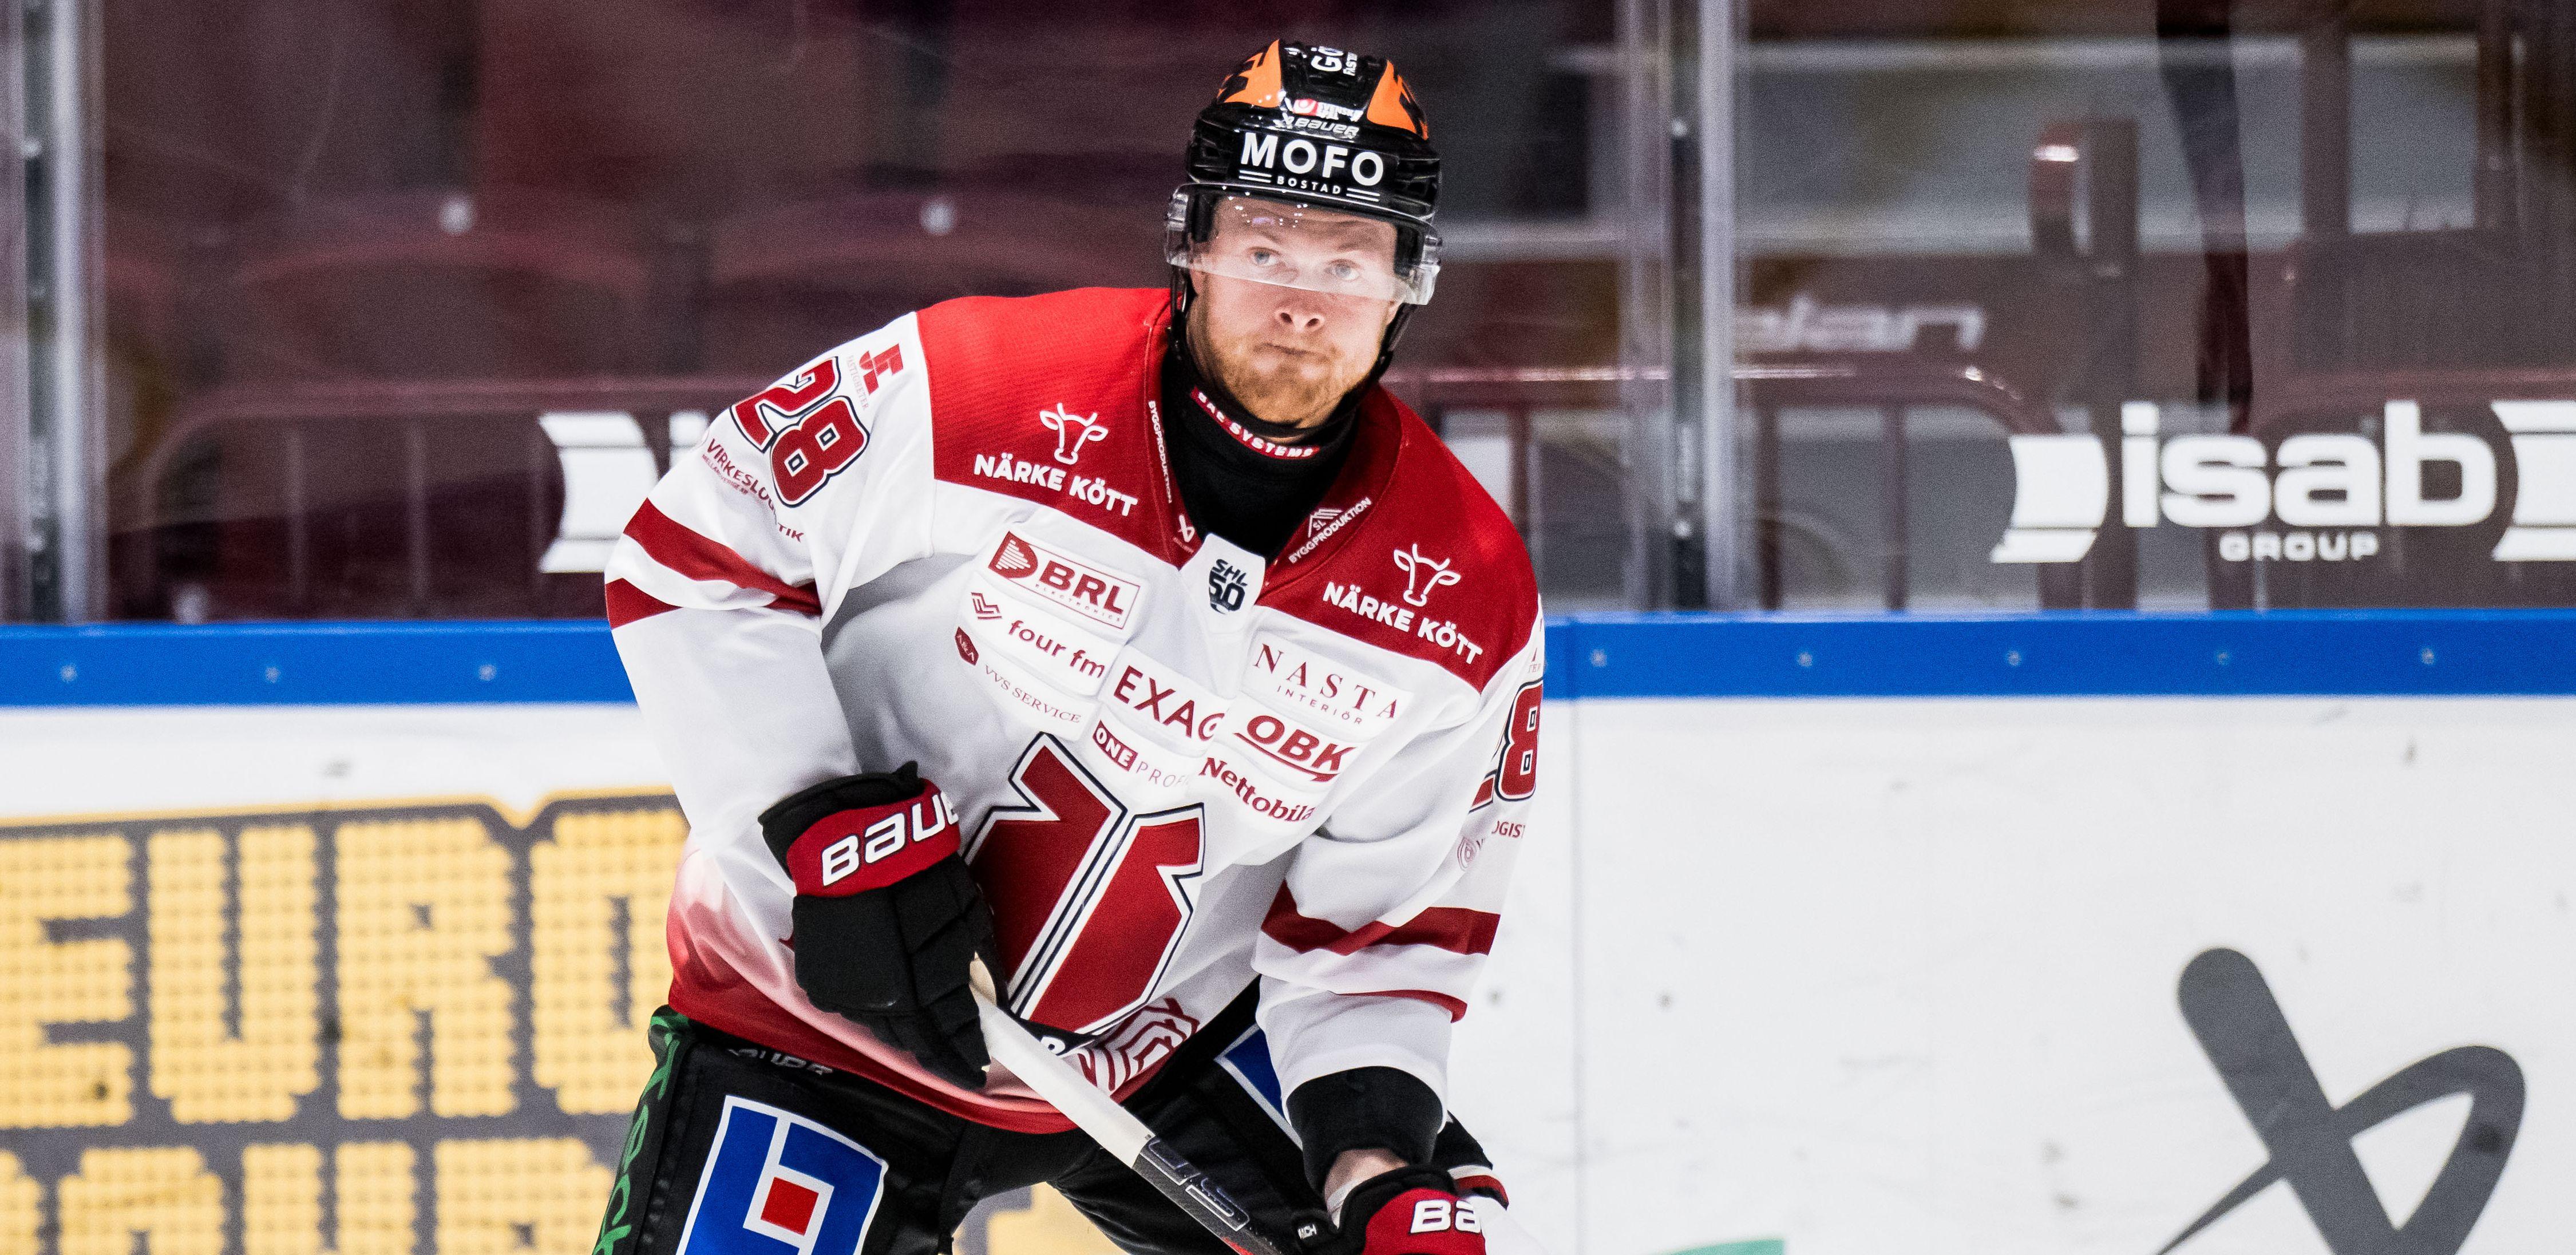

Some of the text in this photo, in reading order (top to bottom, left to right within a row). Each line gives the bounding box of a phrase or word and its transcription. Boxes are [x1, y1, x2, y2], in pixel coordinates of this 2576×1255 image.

[1240, 132, 1384, 186] MOFO
[1277, 176, 1342, 195] BOSTAD
[729, 356, 870, 508] 28
[1229, 422, 1313, 457] SYSTEMS
[974, 452, 1138, 516] NÄRKE KÖTT
[2122, 401, 2496, 528] isab
[1288, 496, 1372, 564] BYGGPRODUKTION
[1313, 520, 1327, 531] SL
[2219, 534, 2379, 561] GROUP
[1039, 560, 1123, 615] BRL
[1208, 572, 1245, 612] 50
[1211, 559, 1248, 587] SHL
[1008, 620, 1067, 658] four
[1069, 650, 1105, 679] fm
[1323, 581, 1483, 664] NÄRKE KÖTT
[984, 664, 1081, 723] VVS SERVICE
[1253, 643, 1398, 720] NASTA
[1277, 685, 1362, 725] INTERIÖR
[1096, 728, 1134, 767] ONE
[1247, 715, 1357, 771] OBK
